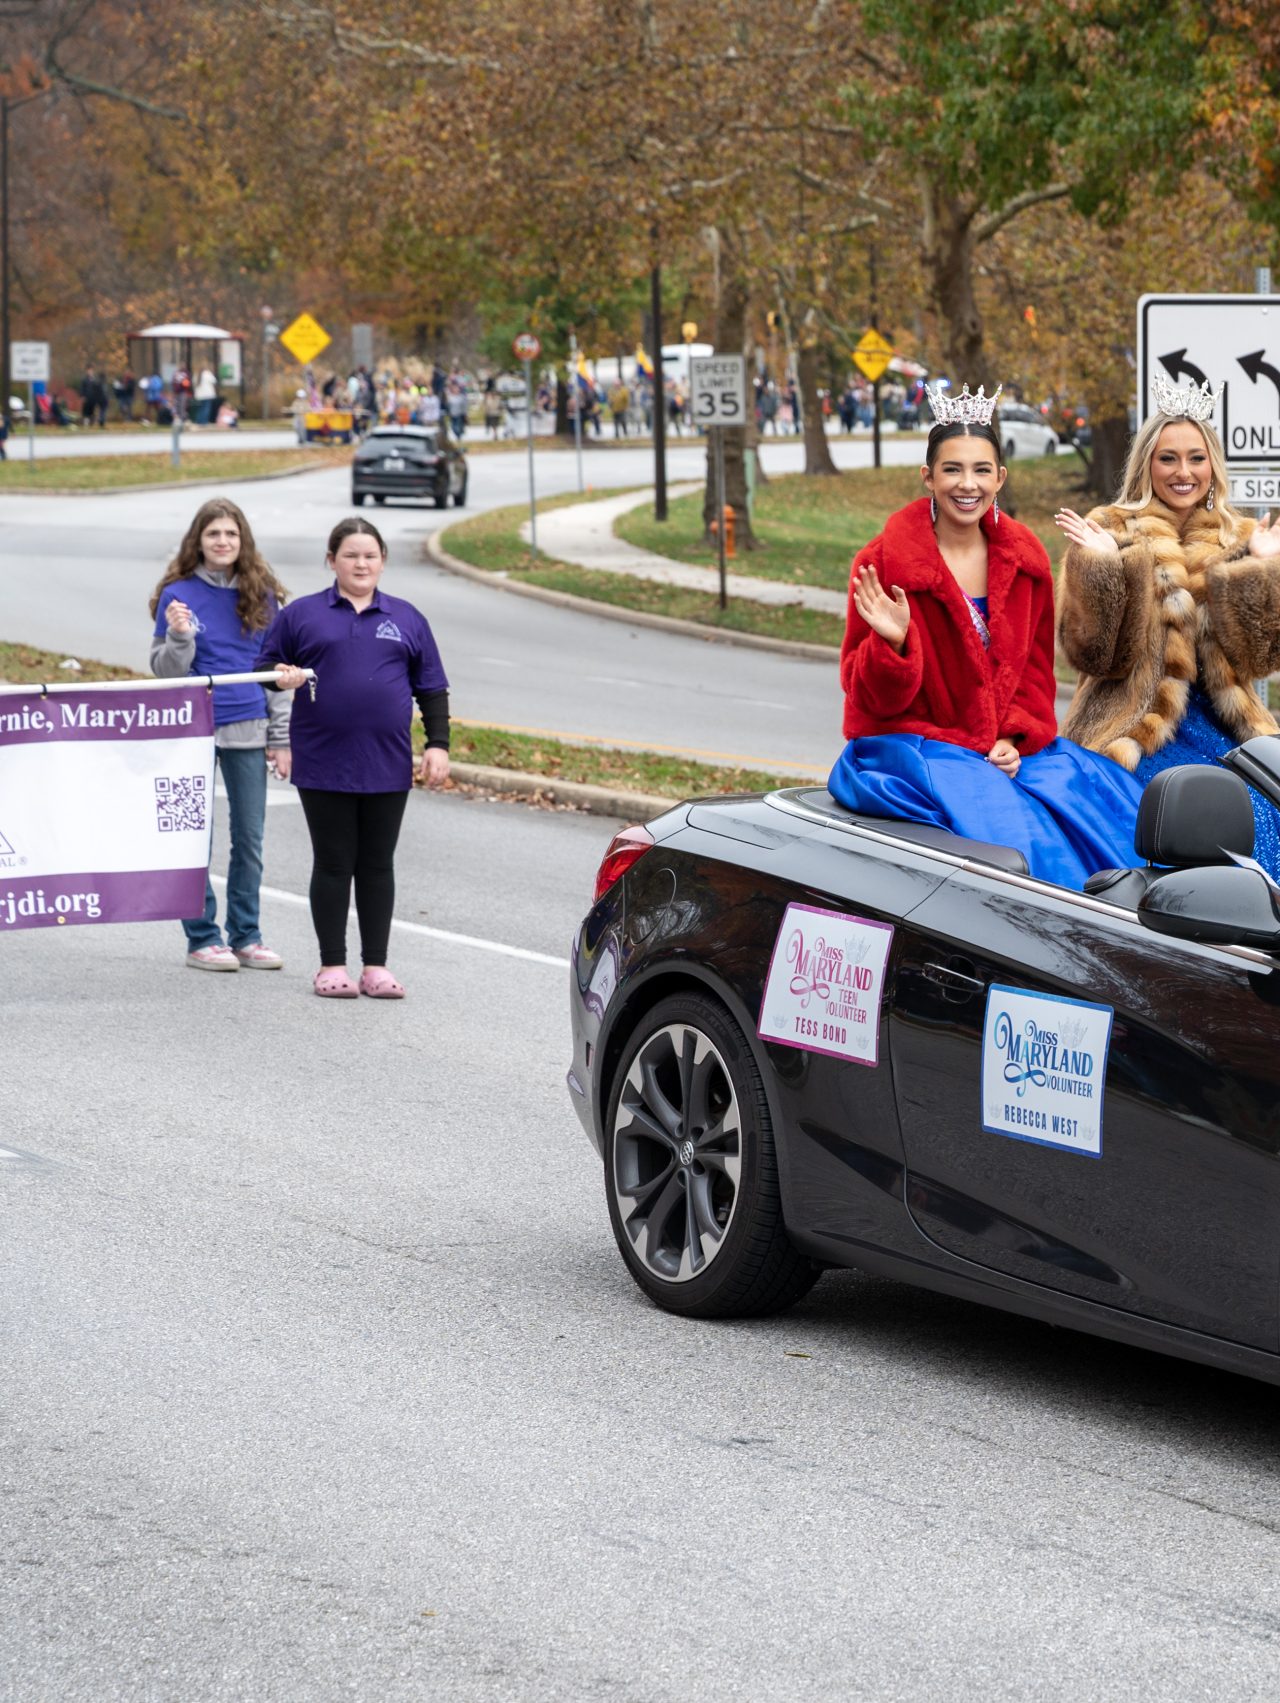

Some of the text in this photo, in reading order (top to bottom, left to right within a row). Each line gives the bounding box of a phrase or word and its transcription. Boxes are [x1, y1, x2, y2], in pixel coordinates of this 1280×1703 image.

[695, 362, 739, 374] SPEED
[699, 377, 734, 388] LIMIT
[698, 392, 740, 417] 35
[61, 701, 193, 734] Maryland
[815, 937, 844, 961] MISS
[786, 929, 873, 1000] MARYLAND
[838, 988, 858, 1006] TEEN
[825, 1000, 867, 1024] VOLUNTEER
[795, 1017, 847, 1044] TESS BOND
[1025, 1020, 1058, 1046] MISS
[994, 1011, 1093, 1087] MARYLAND
[1046, 1074, 1093, 1098] VOLUNTEER
[1004, 1104, 1078, 1137] REBECCA WEST
